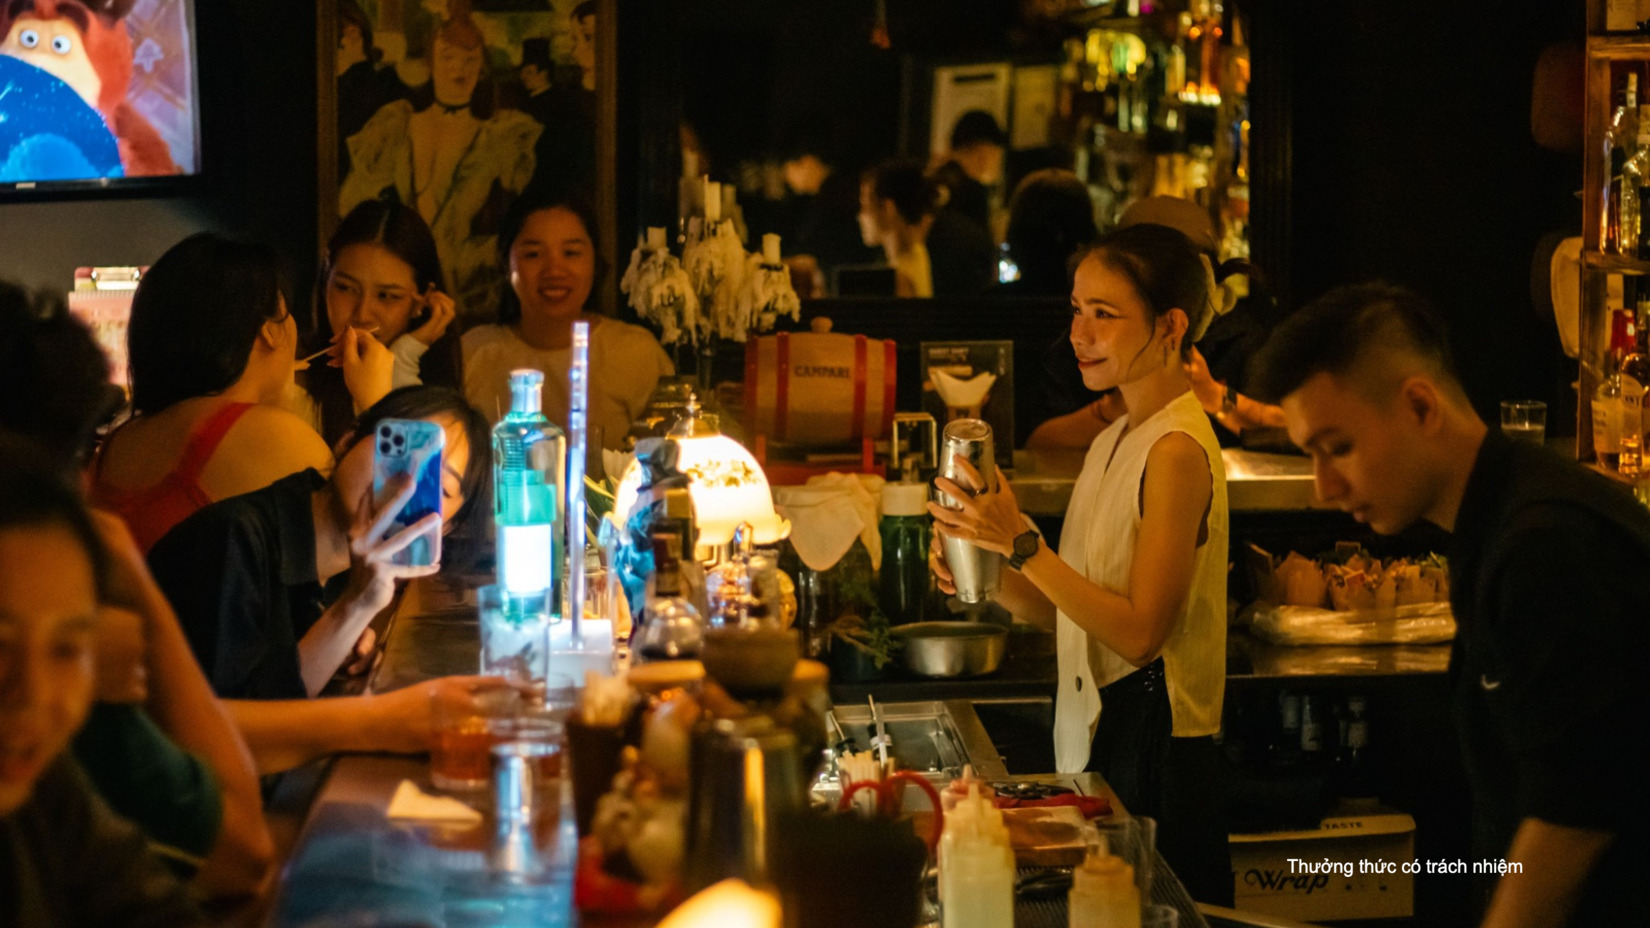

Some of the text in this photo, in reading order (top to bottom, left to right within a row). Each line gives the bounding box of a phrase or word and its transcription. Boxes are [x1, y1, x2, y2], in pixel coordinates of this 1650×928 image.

[794, 364, 851, 379] CAMPARI
[1324, 821, 1363, 830] TASTE
[1243, 868, 1330, 895] Wrap
